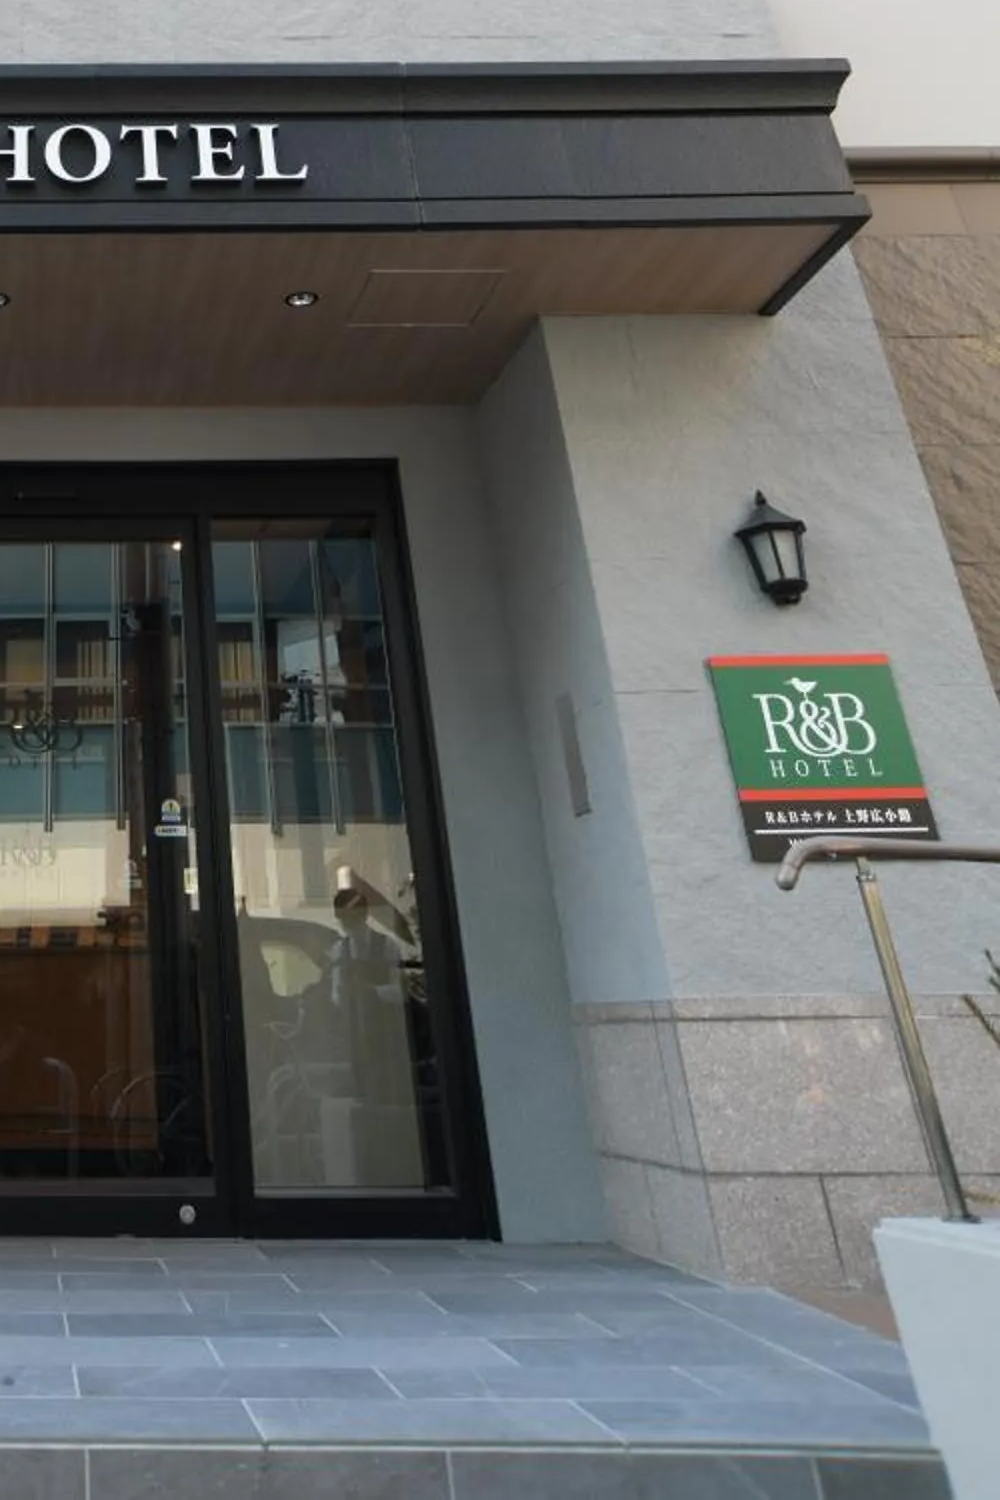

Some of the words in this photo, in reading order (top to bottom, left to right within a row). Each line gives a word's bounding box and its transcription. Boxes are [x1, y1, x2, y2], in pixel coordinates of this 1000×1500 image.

[752, 692, 878, 758] R&B
[769, 758, 884, 778] HOTEL
[765, 811, 837, 825] R&Bホテル
